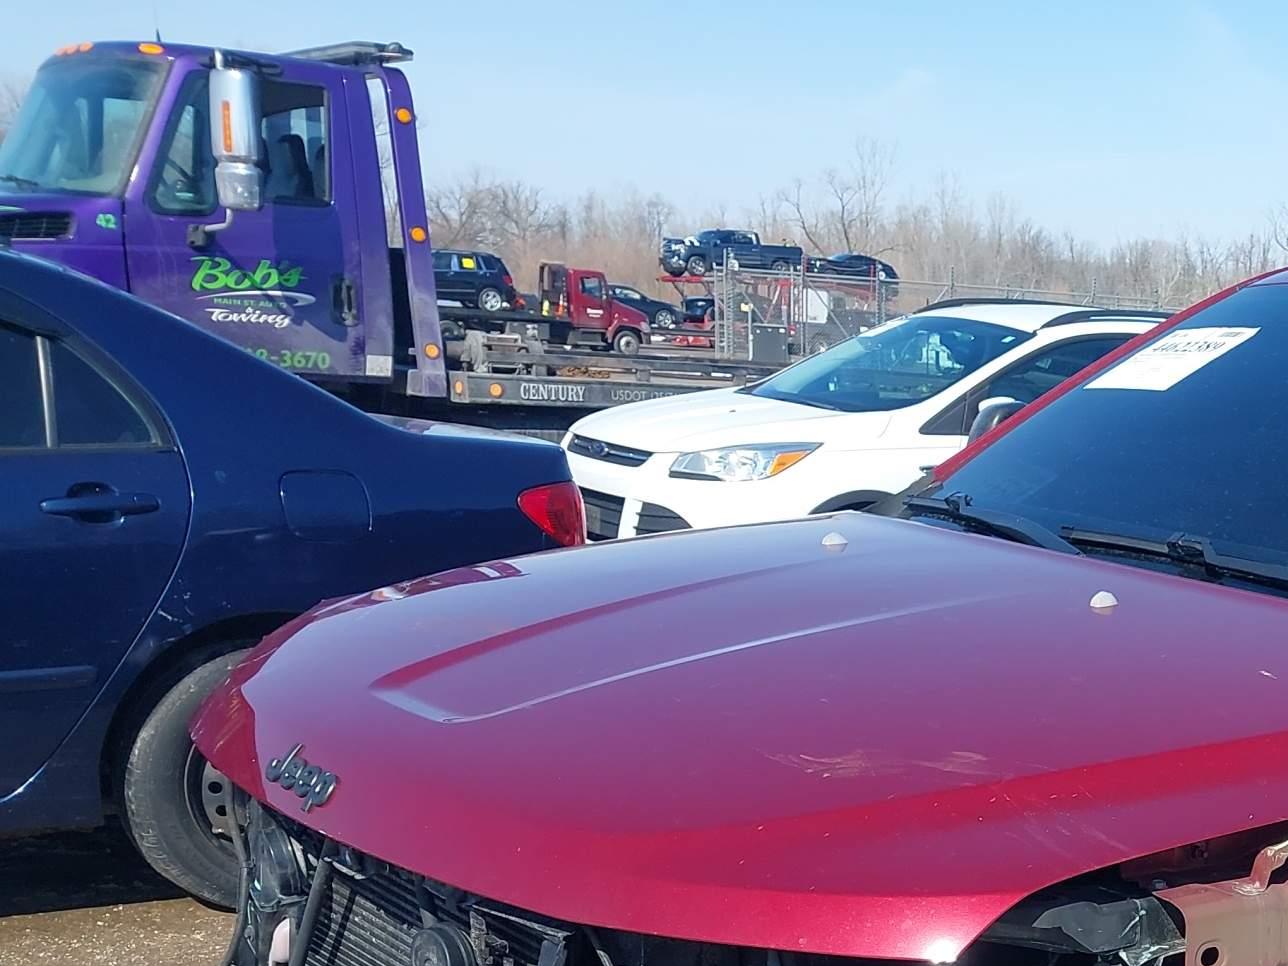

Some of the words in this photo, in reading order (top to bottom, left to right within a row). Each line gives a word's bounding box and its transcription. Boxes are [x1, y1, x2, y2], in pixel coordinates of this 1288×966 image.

[96, 213, 116, 228] 42
[190, 256, 308, 292] Bob's
[204, 306, 292, 328] Towing
[520, 383, 586, 403] CENTURY
[610, 389, 647, 402] USDOT
[265, 743, 337, 812] Jeep
